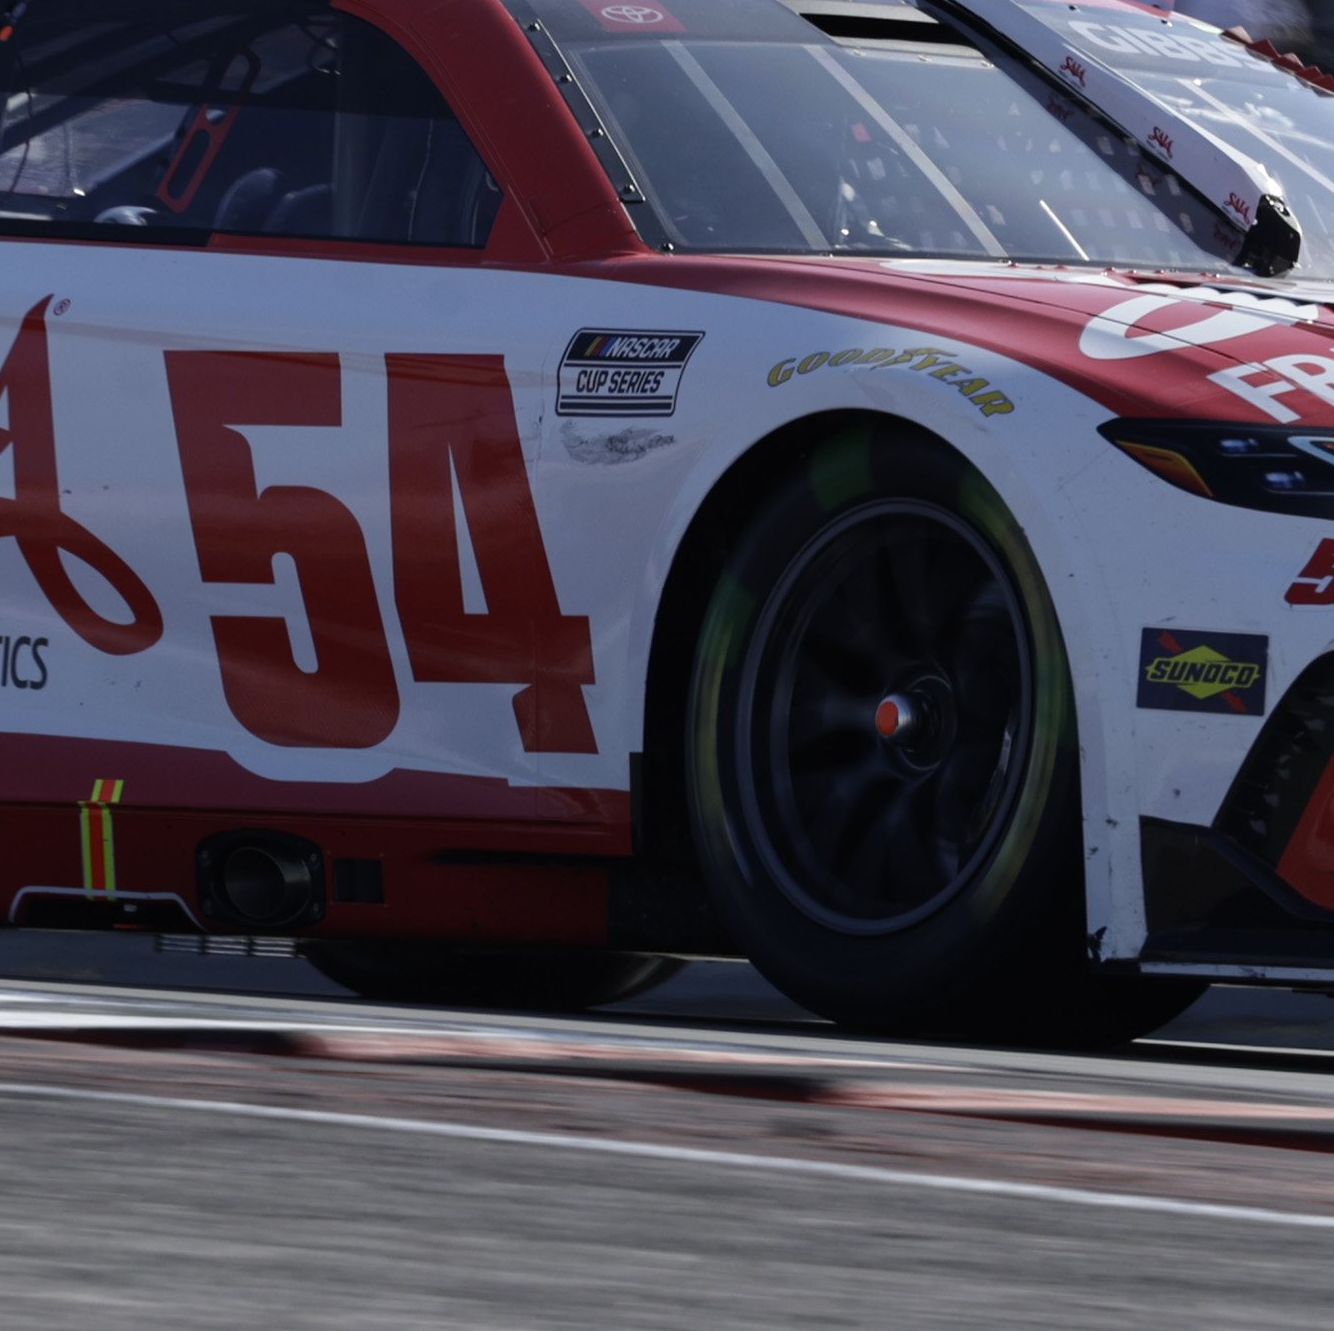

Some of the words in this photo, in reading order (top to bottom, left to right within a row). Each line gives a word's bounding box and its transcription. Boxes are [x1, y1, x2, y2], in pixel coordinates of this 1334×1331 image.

[605, 336, 681, 359] NASCAR
[576, 369, 610, 394] CUP
[608, 370, 665, 394] SERIES
[767, 347, 1015, 418] GOODYEAR
[162, 350, 599, 755] 54
[1149, 659, 1257, 687] SUNOCO
